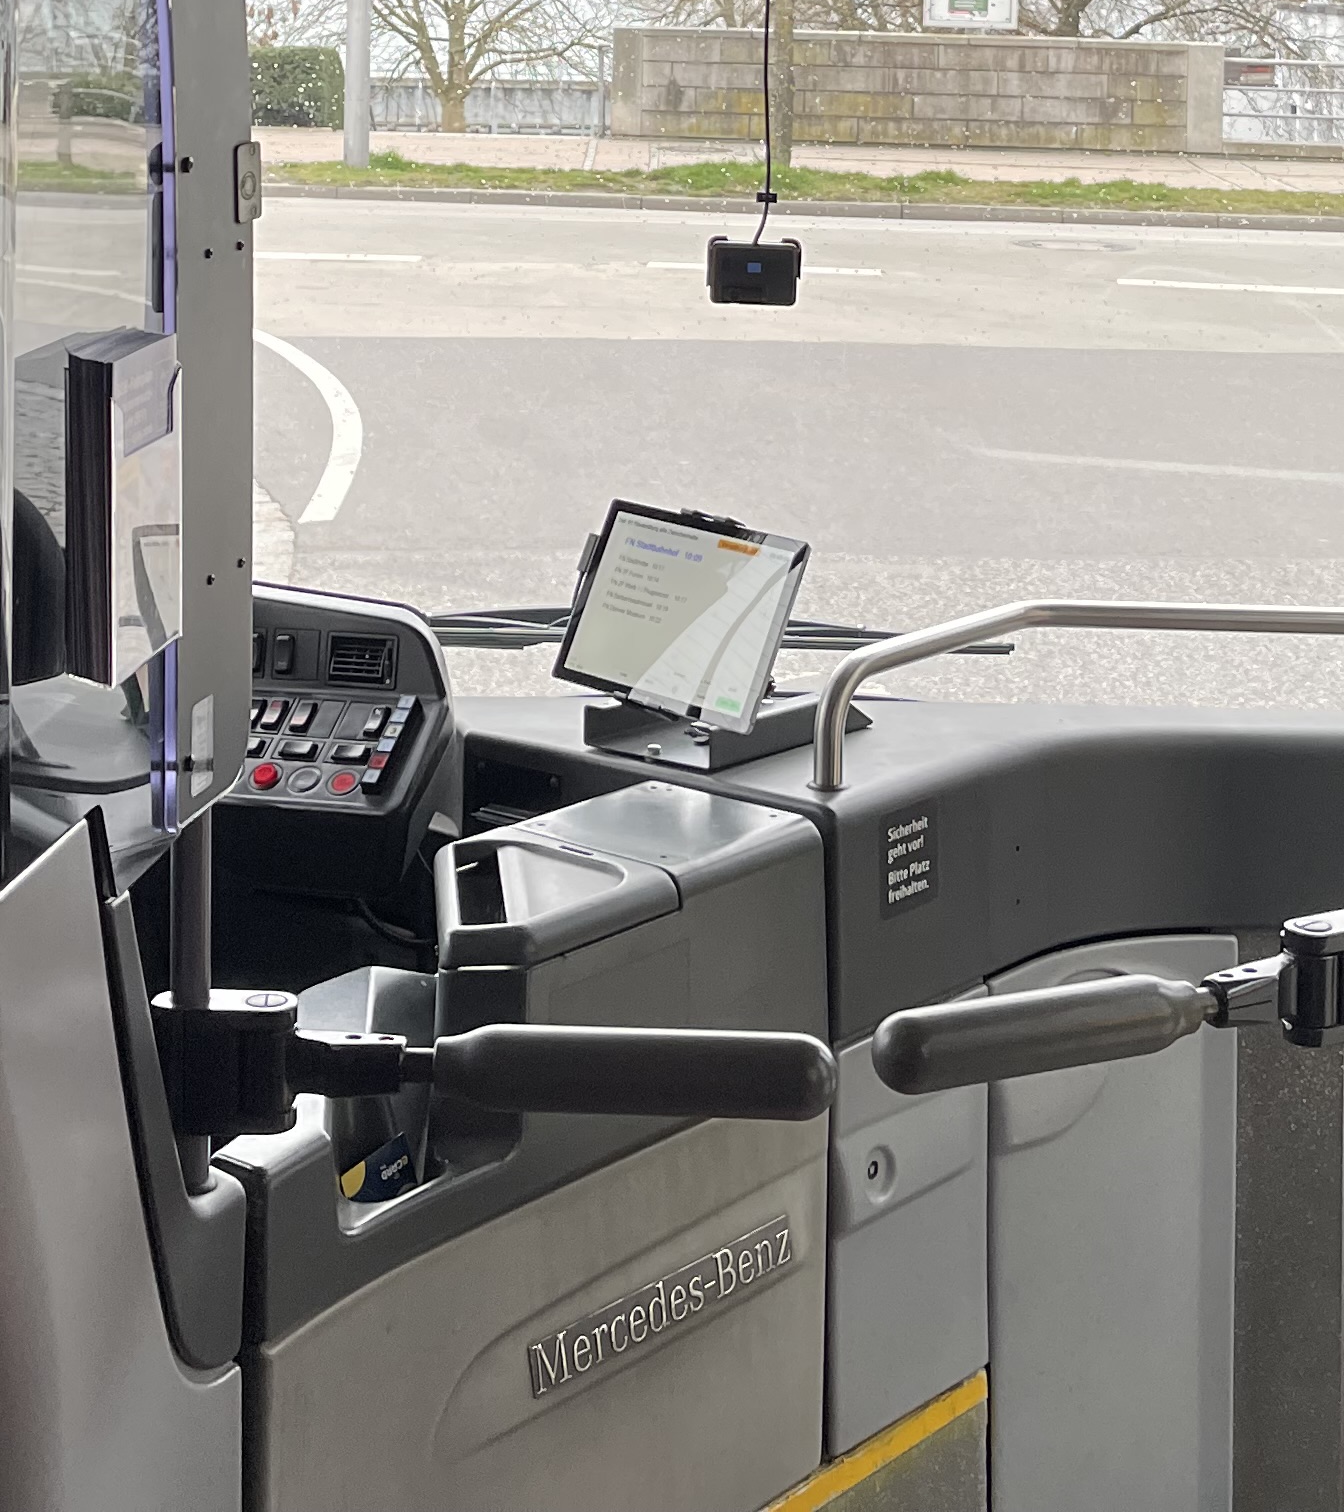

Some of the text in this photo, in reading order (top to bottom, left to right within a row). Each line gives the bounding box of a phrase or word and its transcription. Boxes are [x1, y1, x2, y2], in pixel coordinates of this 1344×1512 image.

[887, 815, 929, 843] Sicherheit
[887, 834, 925, 865] geht vor!
[888, 860, 931, 886] Bitte Platz
[888, 879, 930, 904] freihalten.
[531, 1228, 791, 1395] Mercedes-Benz
